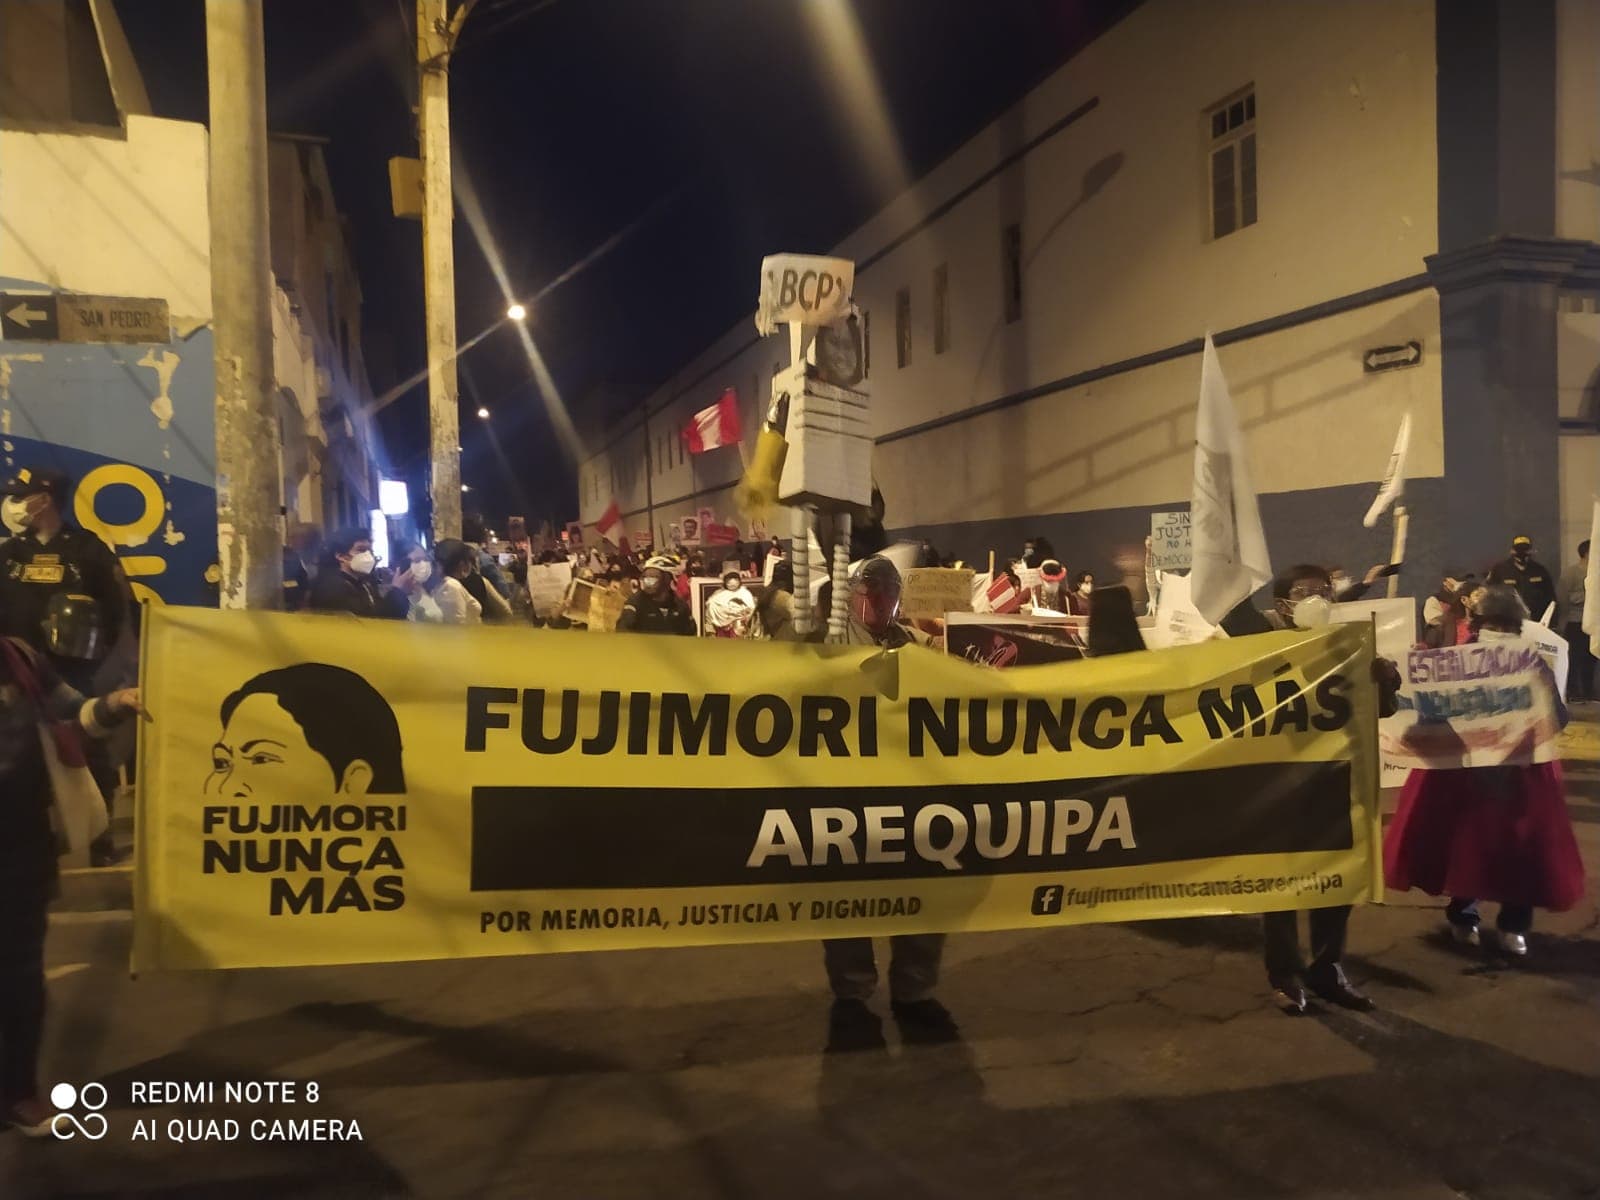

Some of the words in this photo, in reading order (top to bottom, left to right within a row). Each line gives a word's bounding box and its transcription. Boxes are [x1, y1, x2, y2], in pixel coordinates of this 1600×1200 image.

[80, 309, 104, 328] SAN
[110, 309, 151, 329] PEDRO
[1155, 525, 1192, 541] JUST
[1165, 512, 1191, 525] SIN
[464, 686, 879, 758] FUJIMORI
[908, 694, 1183, 758] NUNCA
[1197, 662, 1353, 741] MÁS
[203, 805, 406, 834] FUJIMORI
[745, 796, 1137, 870] AREQUIPA
[203, 837, 405, 874] NUNCA
[270, 870, 405, 915] MÁS
[480, 911, 530, 933] POR
[541, 907, 669, 931] MEMORIA,
[678, 902, 779, 927] JUSTICIA
[788, 901, 802, 921] Y
[810, 896, 921, 921] DIGNIDAD
